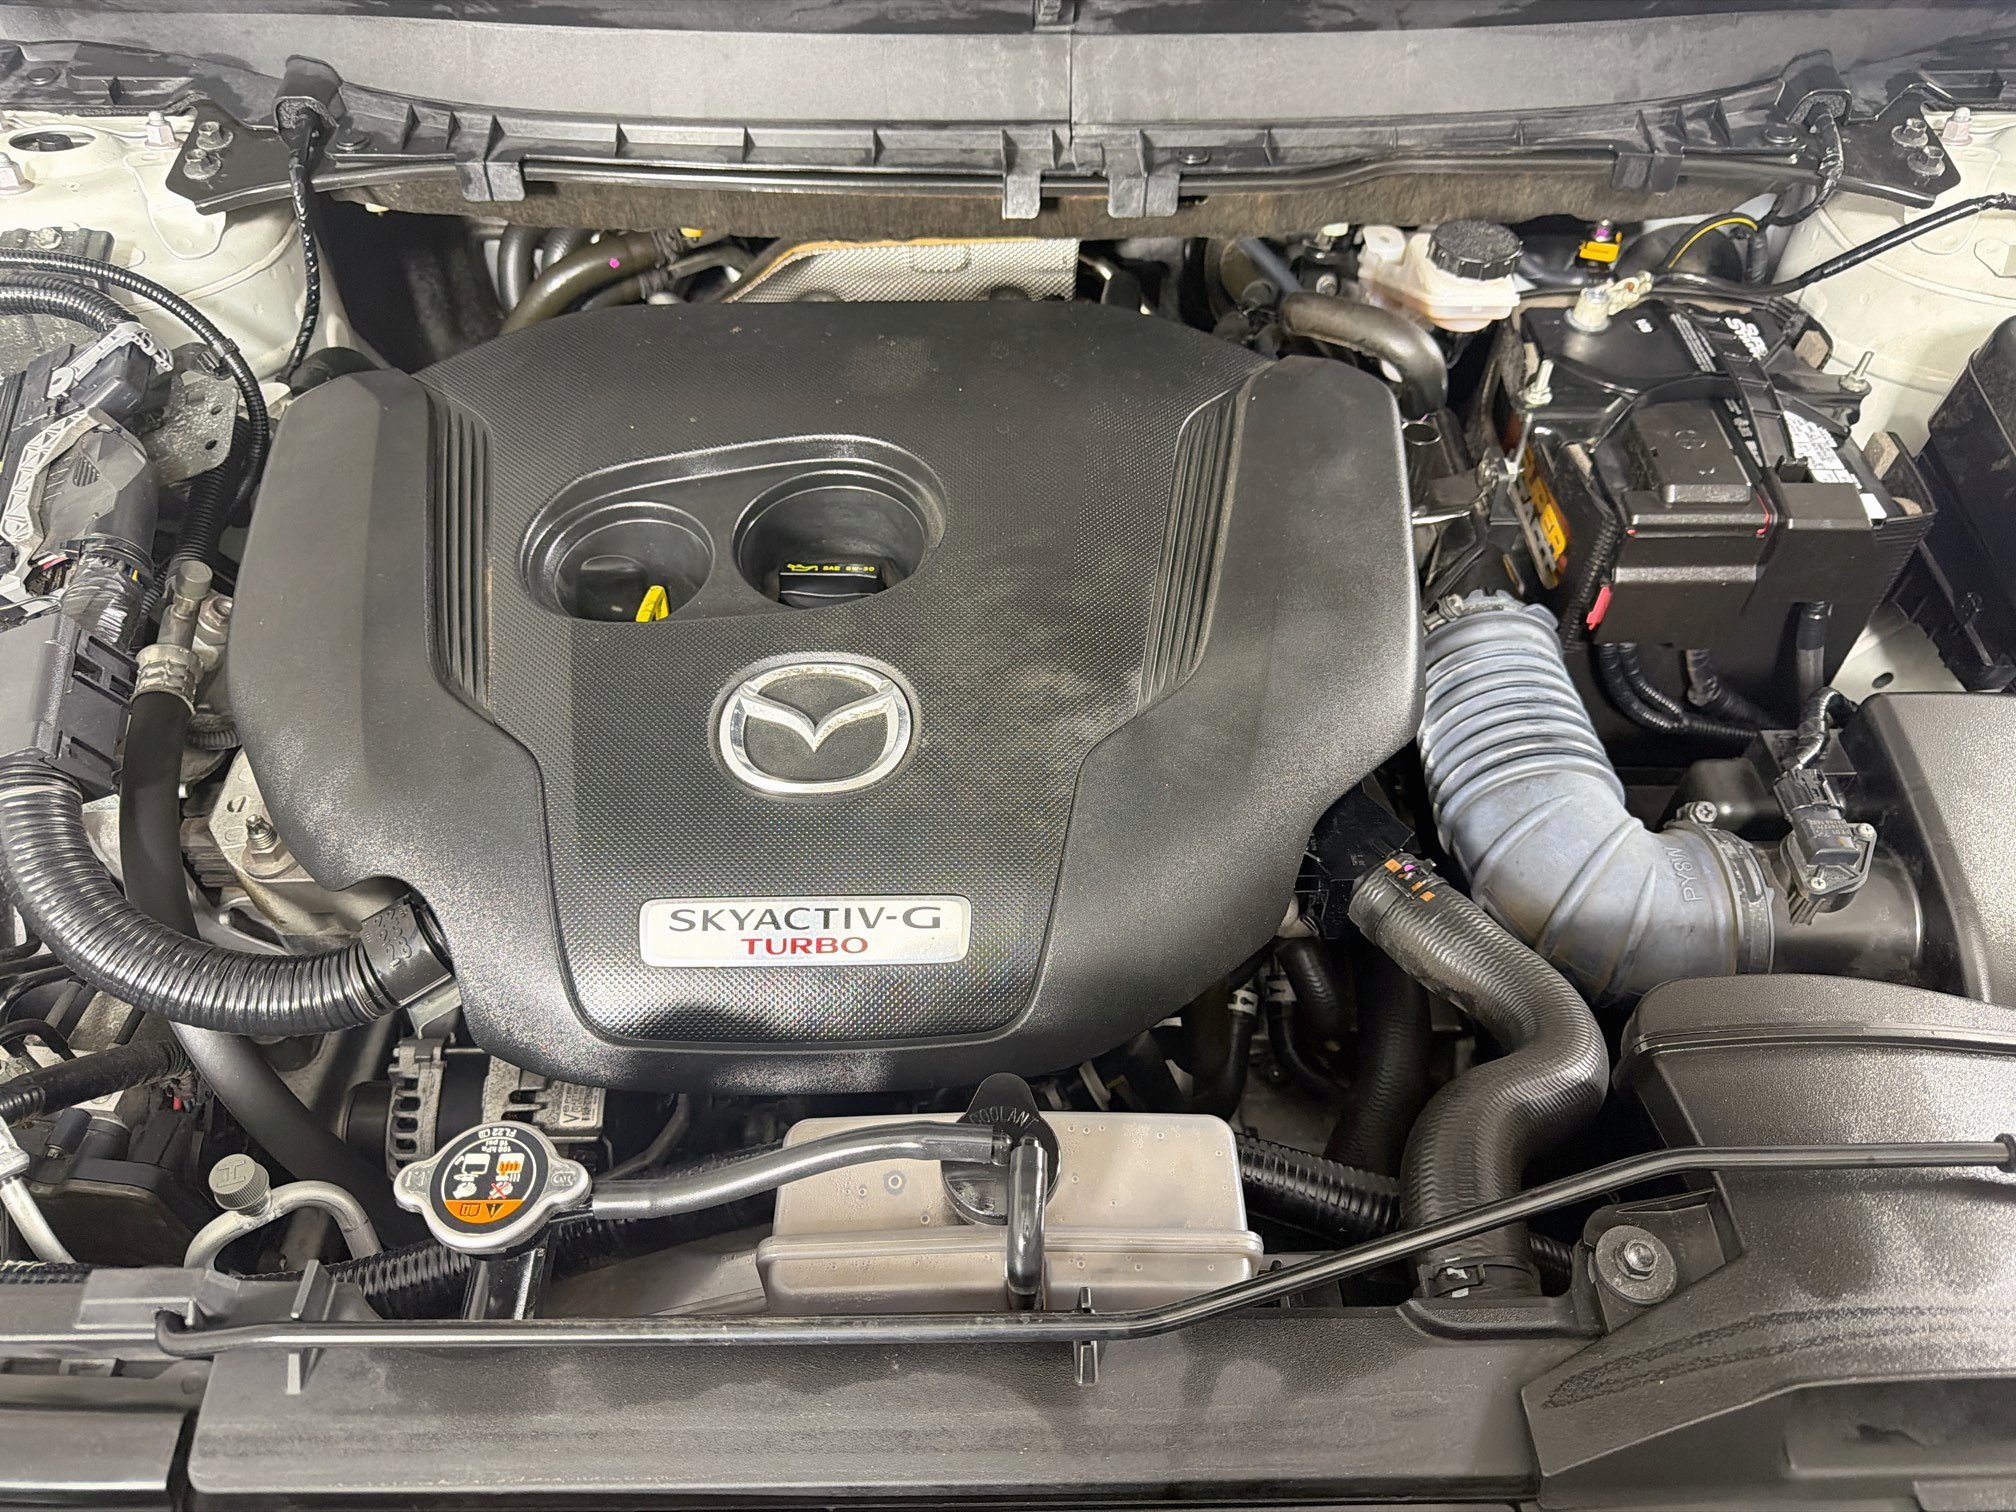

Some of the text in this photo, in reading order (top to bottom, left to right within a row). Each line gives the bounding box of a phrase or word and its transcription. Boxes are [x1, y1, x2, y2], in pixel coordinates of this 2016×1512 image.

[668, 906, 941, 932] SKYACTIV-G
[741, 937, 868, 955] TURBO
[491, 1127, 517, 1138] FL22
